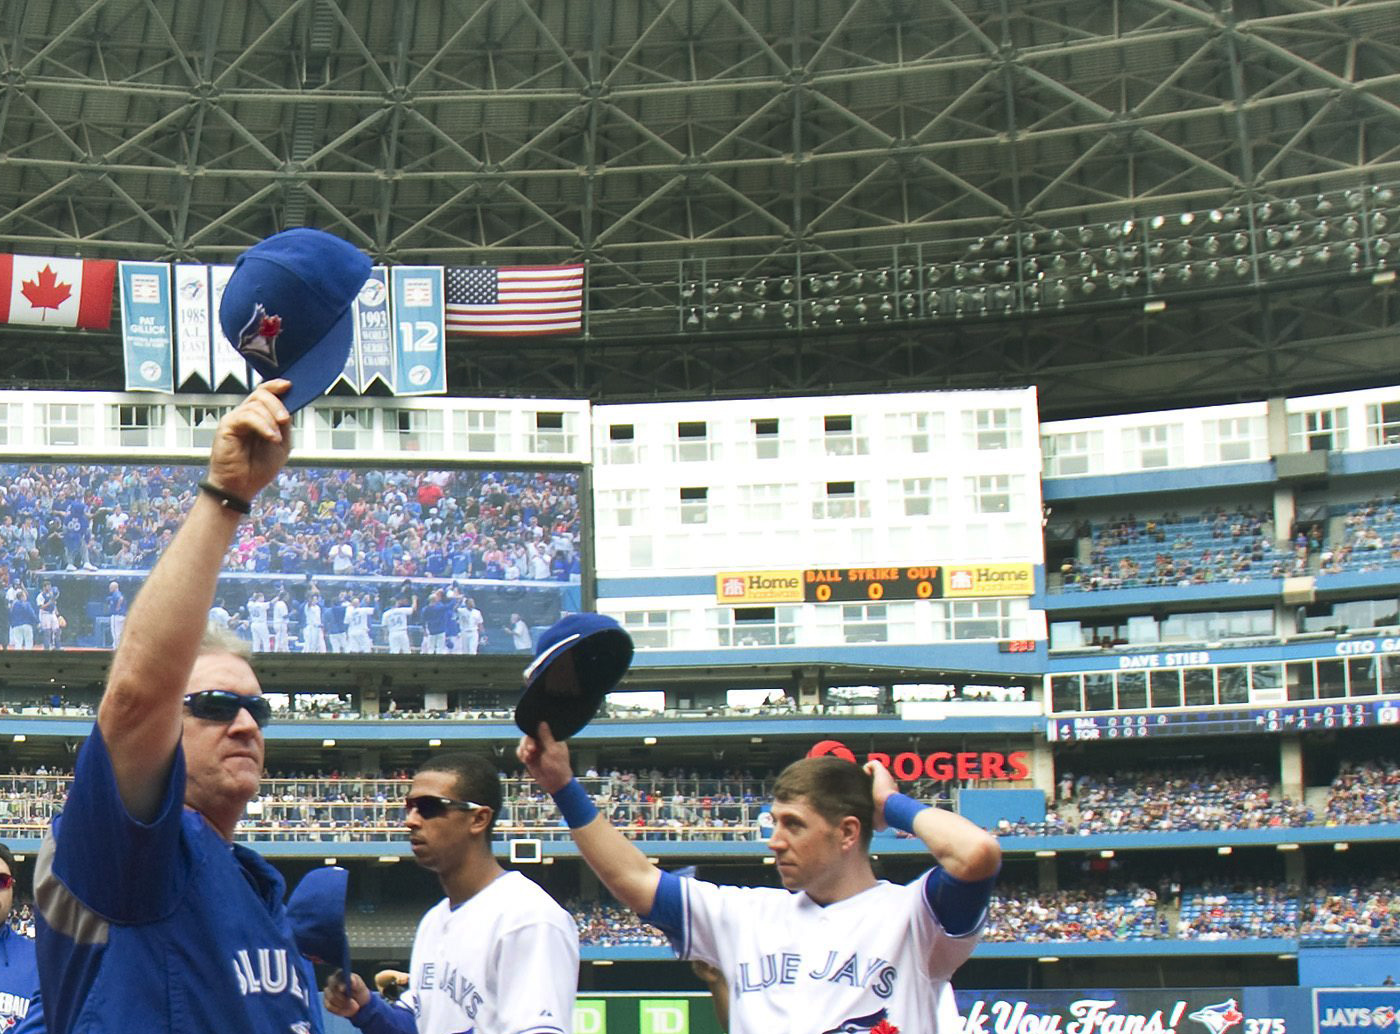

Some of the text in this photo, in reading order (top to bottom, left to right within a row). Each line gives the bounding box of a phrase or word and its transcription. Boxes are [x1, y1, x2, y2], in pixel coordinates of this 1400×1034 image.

[139, 316, 156, 325] PAT
[181, 308, 206, 324] 1985
[361, 311, 387, 328] 1993
[130, 324, 166, 335] GILLICK
[399, 321, 439, 352] 12
[748, 575, 799, 589] Home
[806, 567, 938, 583] BALL STRIKE OUT
[976, 568, 1029, 583] Home
[816, 581, 933, 602] 0 0 0
[1335, 640, 1376, 656] CITO
[1119, 651, 1210, 669] DAVE STIEB
[1075, 728, 1100, 741] TOR
[809, 950, 898, 999] JAYS
[439, 961, 484, 1020] JAYS
[645, 1007, 684, 1034] TD
[1320, 1008, 1372, 1028] JAYS
